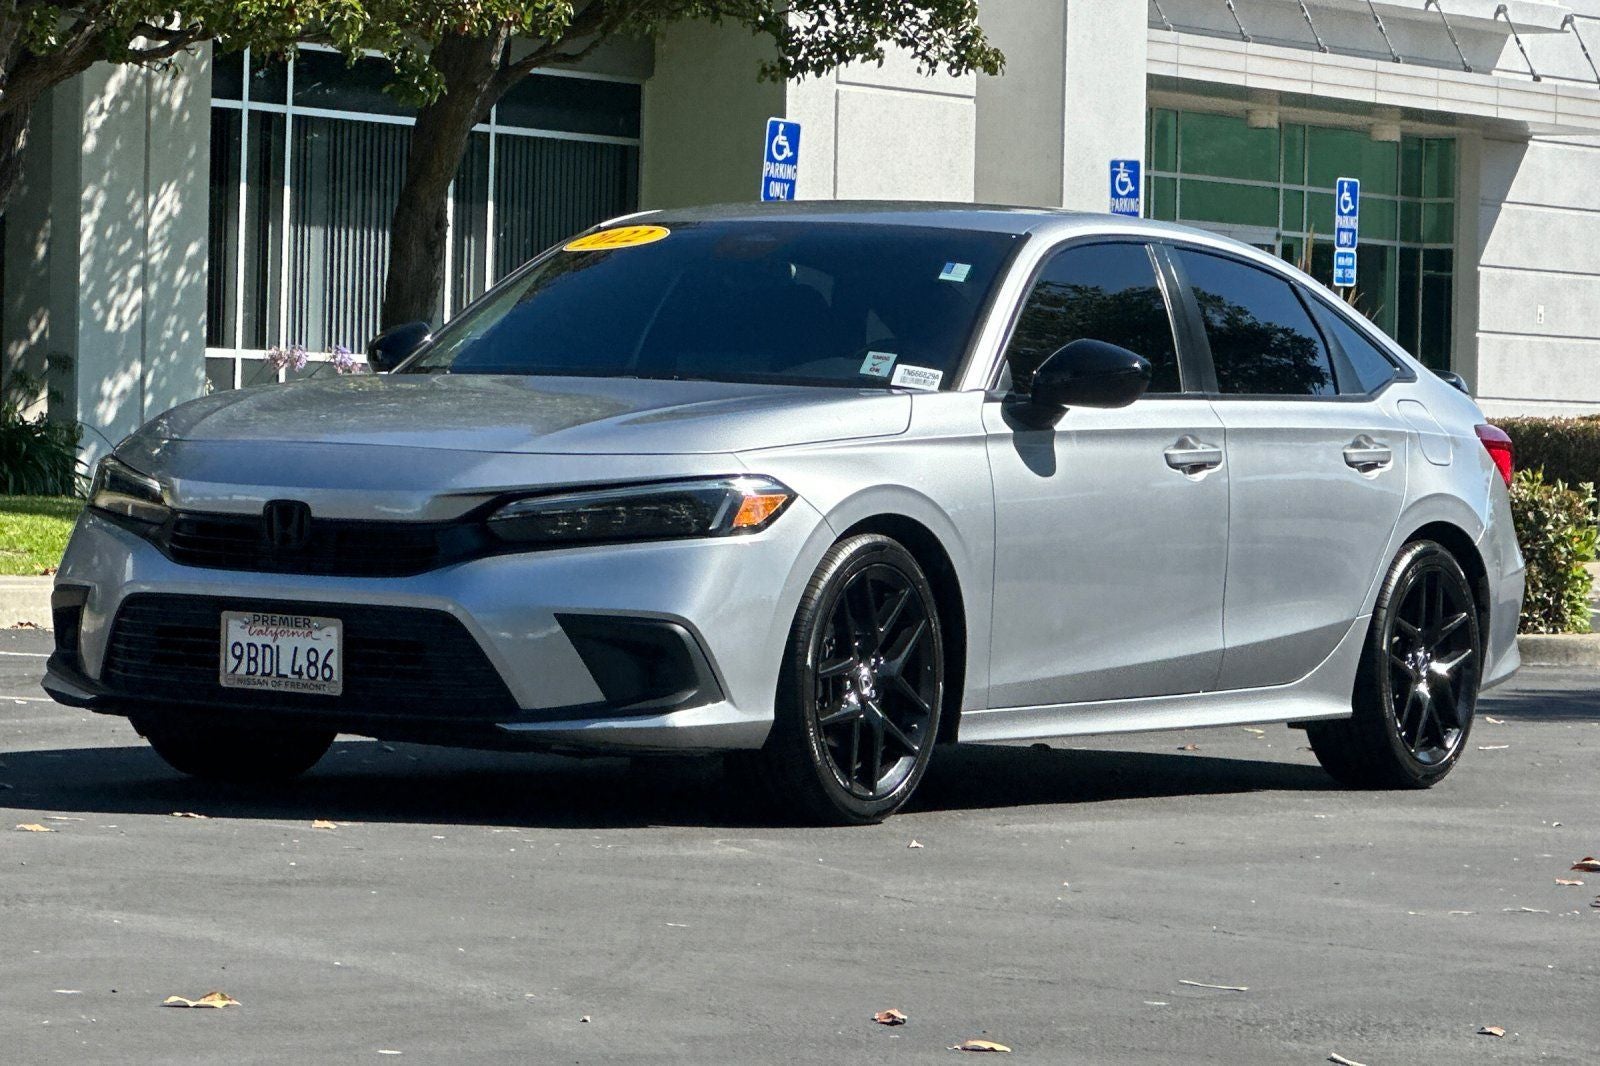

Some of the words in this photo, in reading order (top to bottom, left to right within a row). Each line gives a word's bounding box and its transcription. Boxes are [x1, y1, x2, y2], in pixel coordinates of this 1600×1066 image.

[764, 161, 797, 181] PARKING
[768, 181, 790, 200] ONLY
[1110, 197, 1139, 213] PARKING
[1336, 215, 1357, 229] PARKING
[252, 614, 312, 629] PREMIER
[230, 641, 335, 683] 9BDL486
[236, 676, 269, 687] NISSAN
[270, 680, 283, 688] OF
[284, 681, 327, 692] FREMONT
